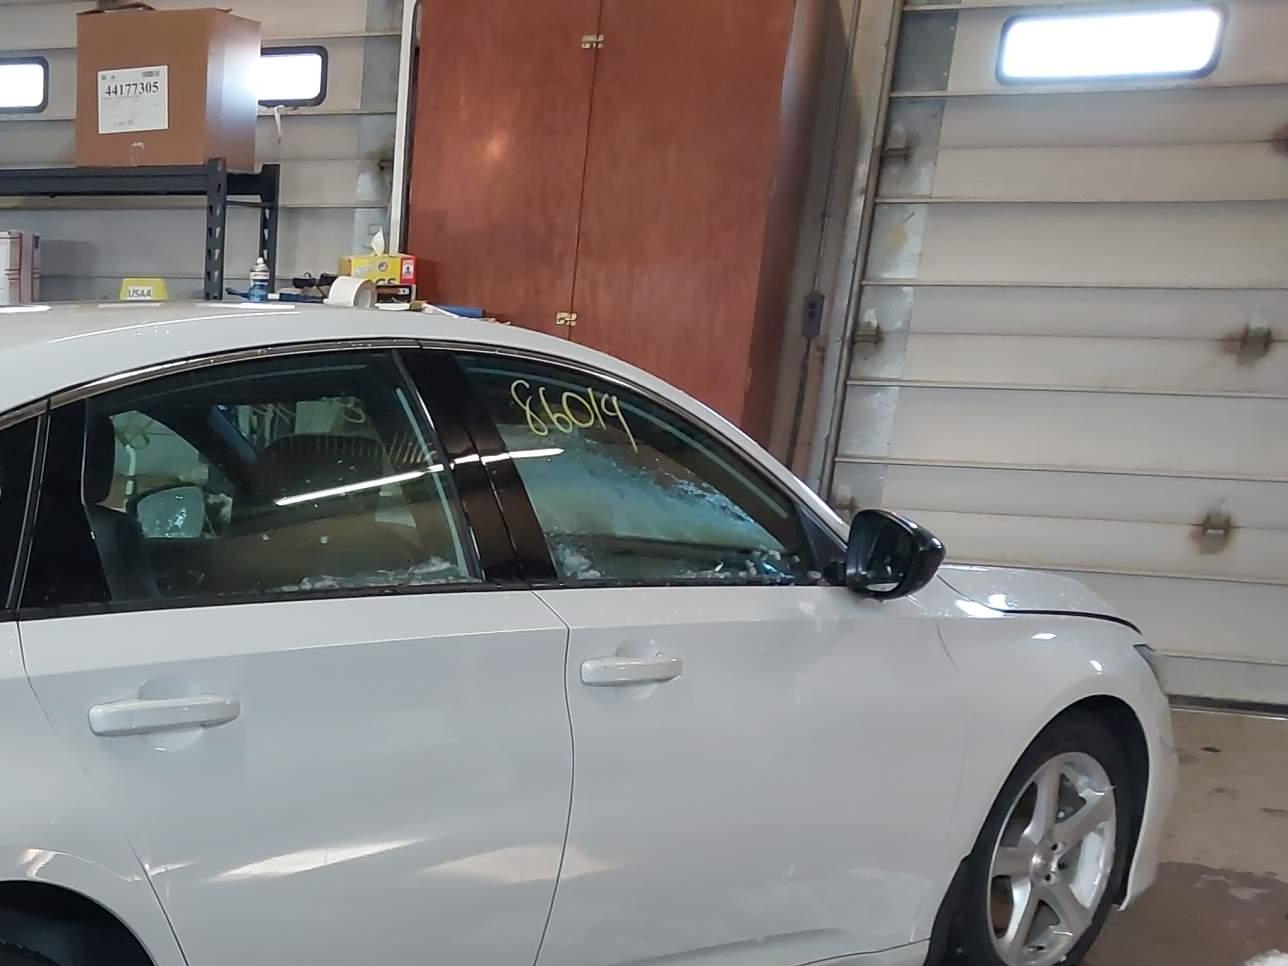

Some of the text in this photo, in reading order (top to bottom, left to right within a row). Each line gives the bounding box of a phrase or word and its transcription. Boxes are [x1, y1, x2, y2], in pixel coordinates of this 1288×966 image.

[105, 81, 159, 96] 44177305
[128, 288, 152, 298] USAA
[511, 379, 639, 454] 86019
